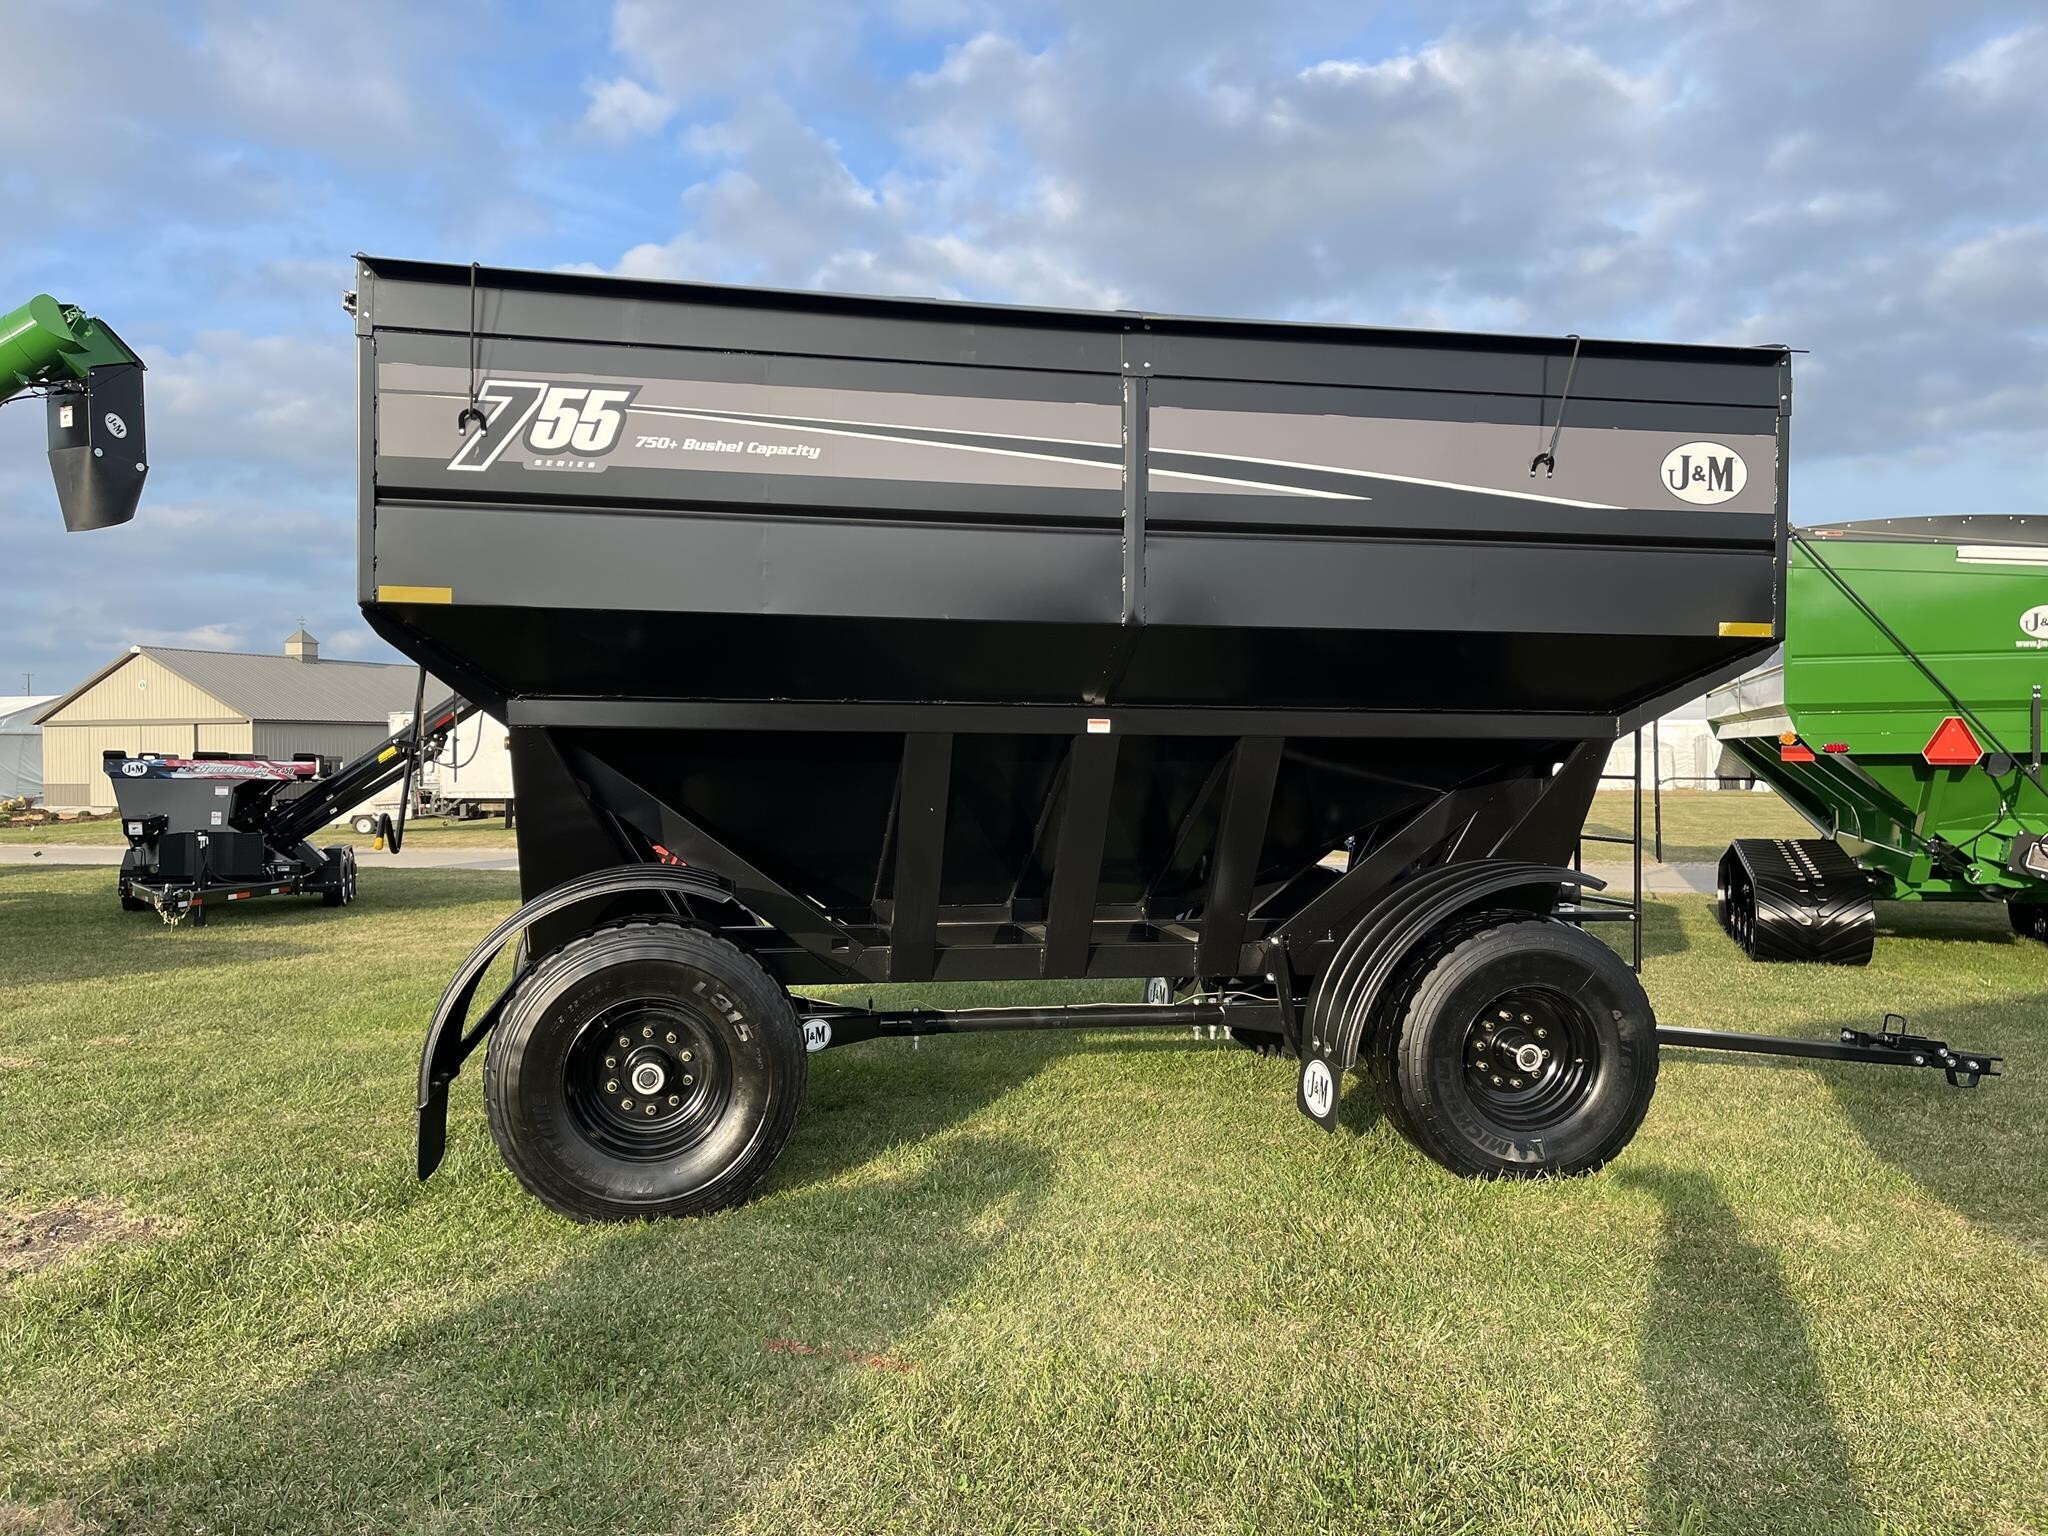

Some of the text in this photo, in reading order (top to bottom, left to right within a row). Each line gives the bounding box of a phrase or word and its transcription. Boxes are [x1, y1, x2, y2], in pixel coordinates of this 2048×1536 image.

[106, 416, 125, 436] J&M
[446, 379, 631, 472] 755
[634, 435, 822, 460] 750+ Bushel Capacity
[533, 459, 597, 469] SERIES
[1667, 454, 1735, 493] J&M
[2025, 612, 2048, 632] J&
[124, 764, 144, 774] J&M
[1307, 1070, 1330, 1108] J&M
